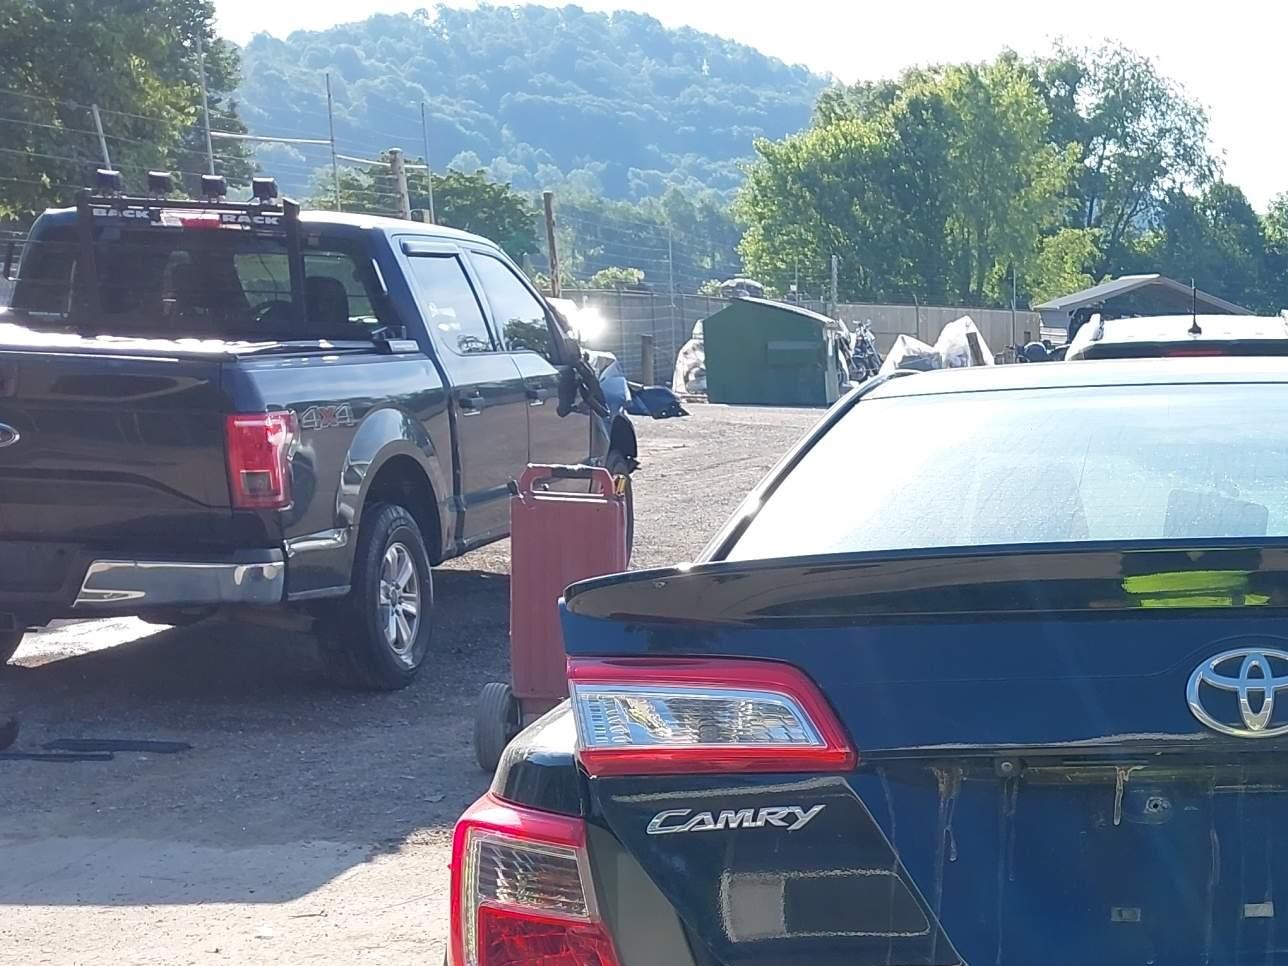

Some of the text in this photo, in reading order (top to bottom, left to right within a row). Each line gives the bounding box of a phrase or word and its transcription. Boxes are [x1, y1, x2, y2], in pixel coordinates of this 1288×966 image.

[93, 208, 280, 225] BACK RACK
[646, 804, 826, 834] CAMRY
